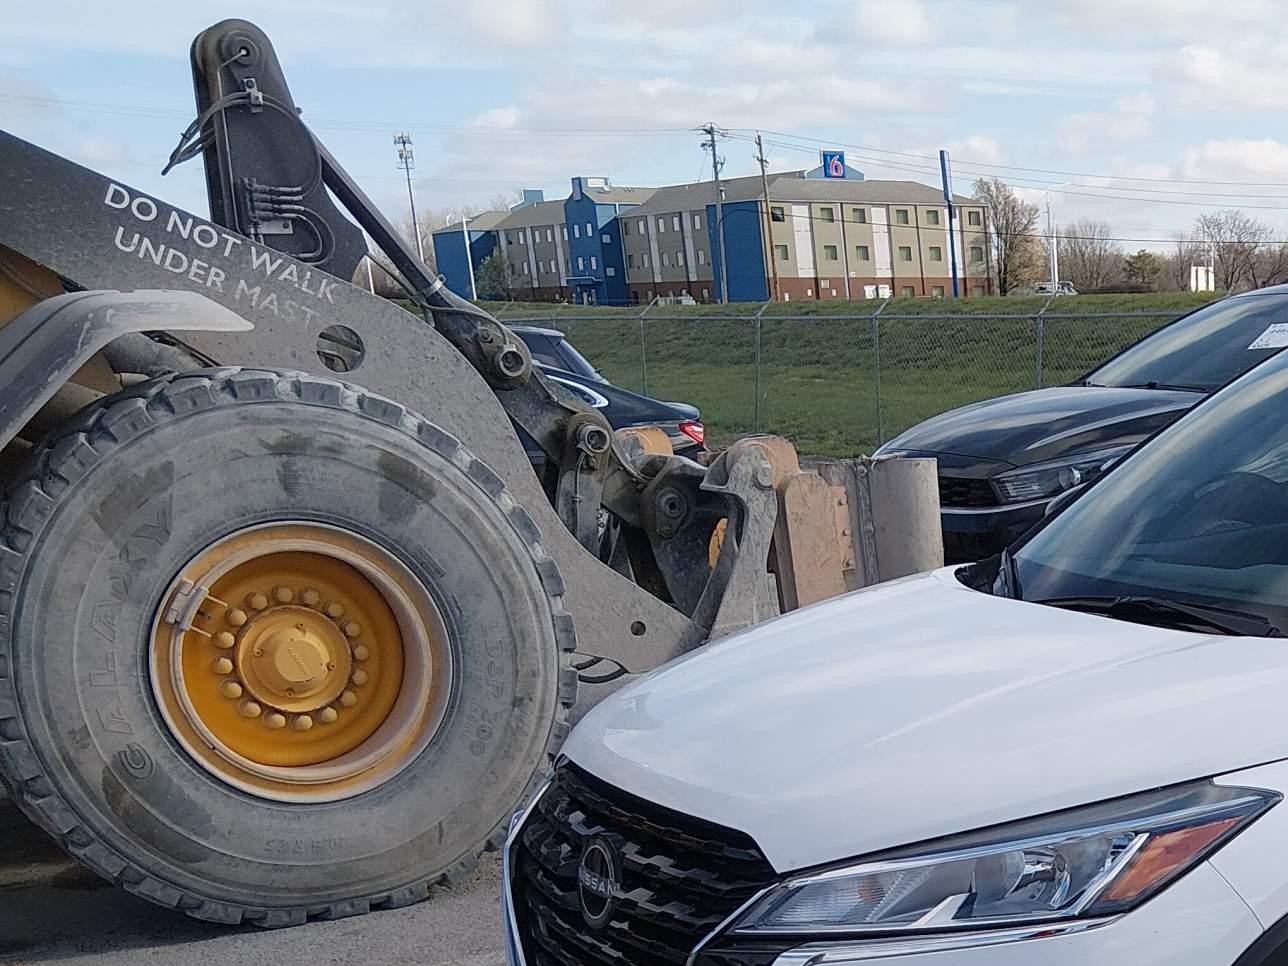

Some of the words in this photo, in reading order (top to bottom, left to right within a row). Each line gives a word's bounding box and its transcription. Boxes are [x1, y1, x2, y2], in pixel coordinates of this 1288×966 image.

[830, 155, 844, 177] 6
[104, 182, 158, 222] DO
[166, 210, 242, 257] NOT
[250, 246, 340, 304] WALK
[114, 226, 226, 293] UNDER
[234, 279, 320, 329] MAST
[88, 507, 173, 780] GALAXY
